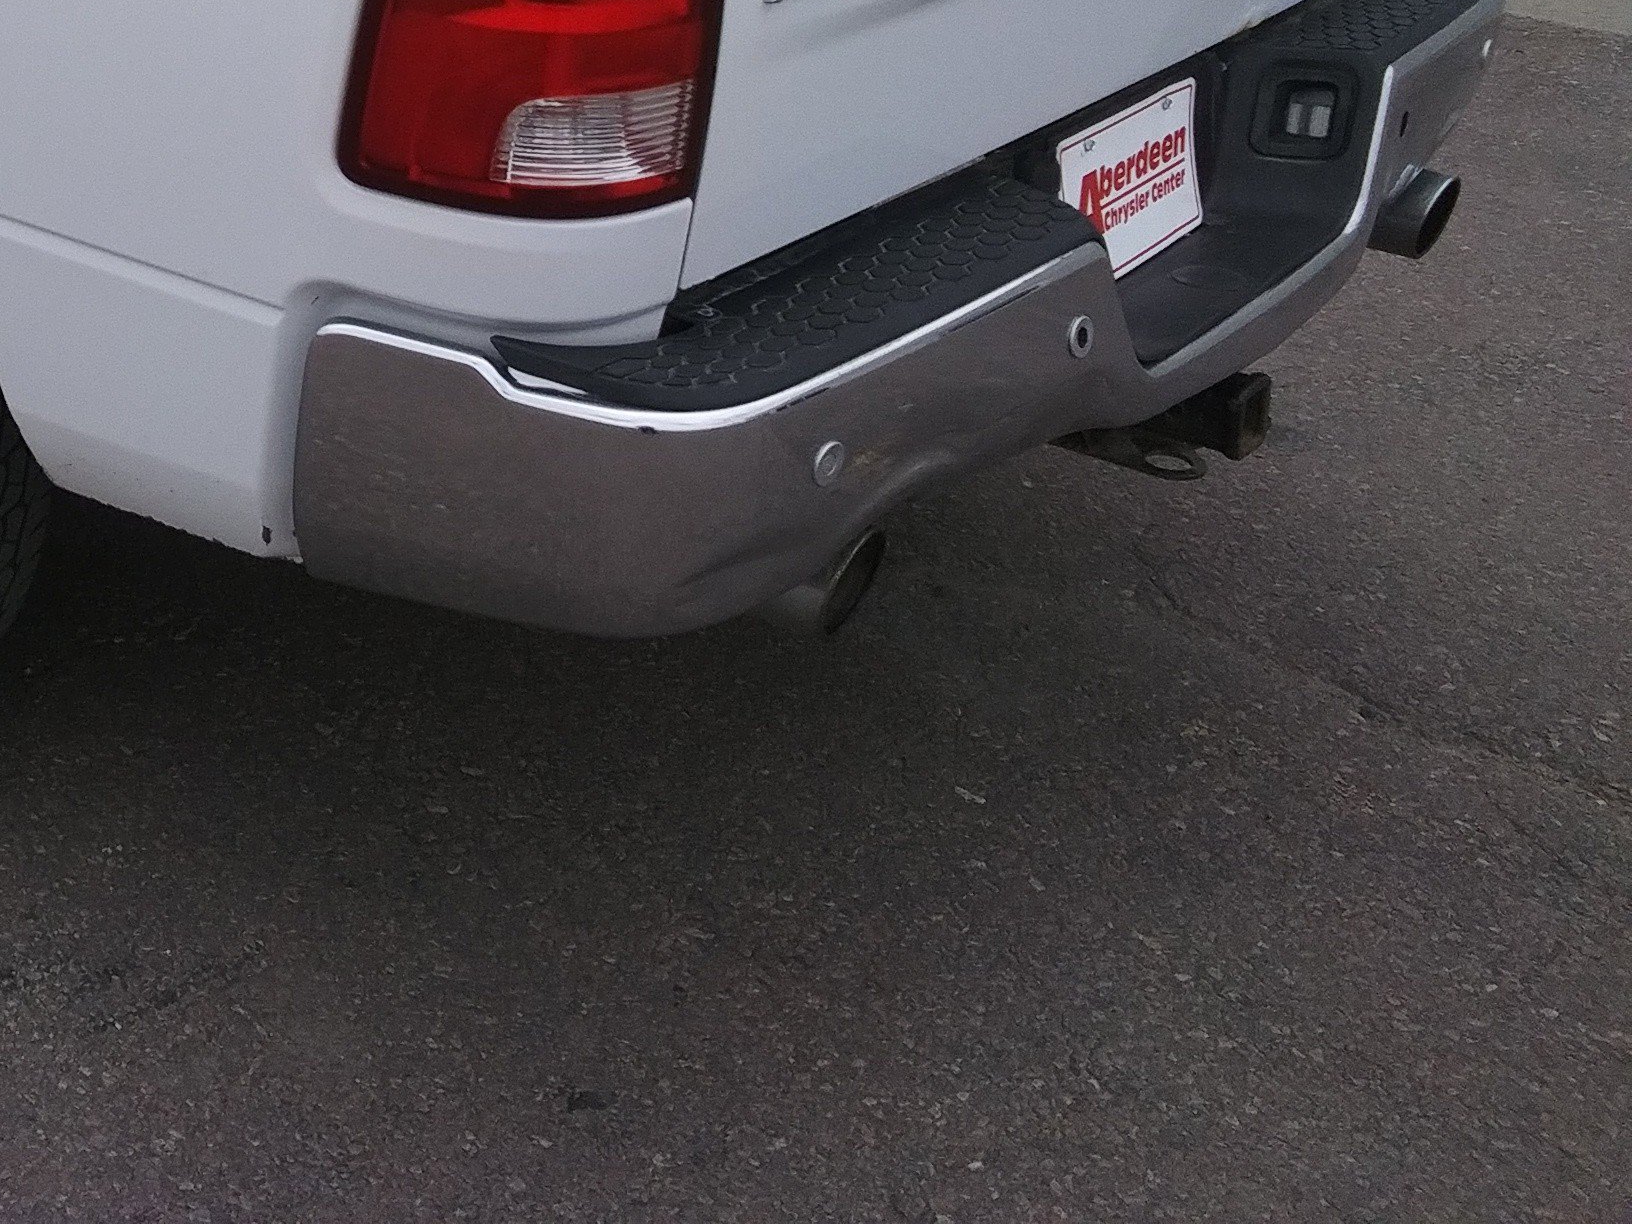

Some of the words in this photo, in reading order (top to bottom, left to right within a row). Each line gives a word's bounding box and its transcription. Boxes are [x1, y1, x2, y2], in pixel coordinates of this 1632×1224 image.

[1079, 126, 1186, 234] Aberdeen
[1104, 190, 1150, 231] Chrysler
[1152, 168, 1186, 203] Center
